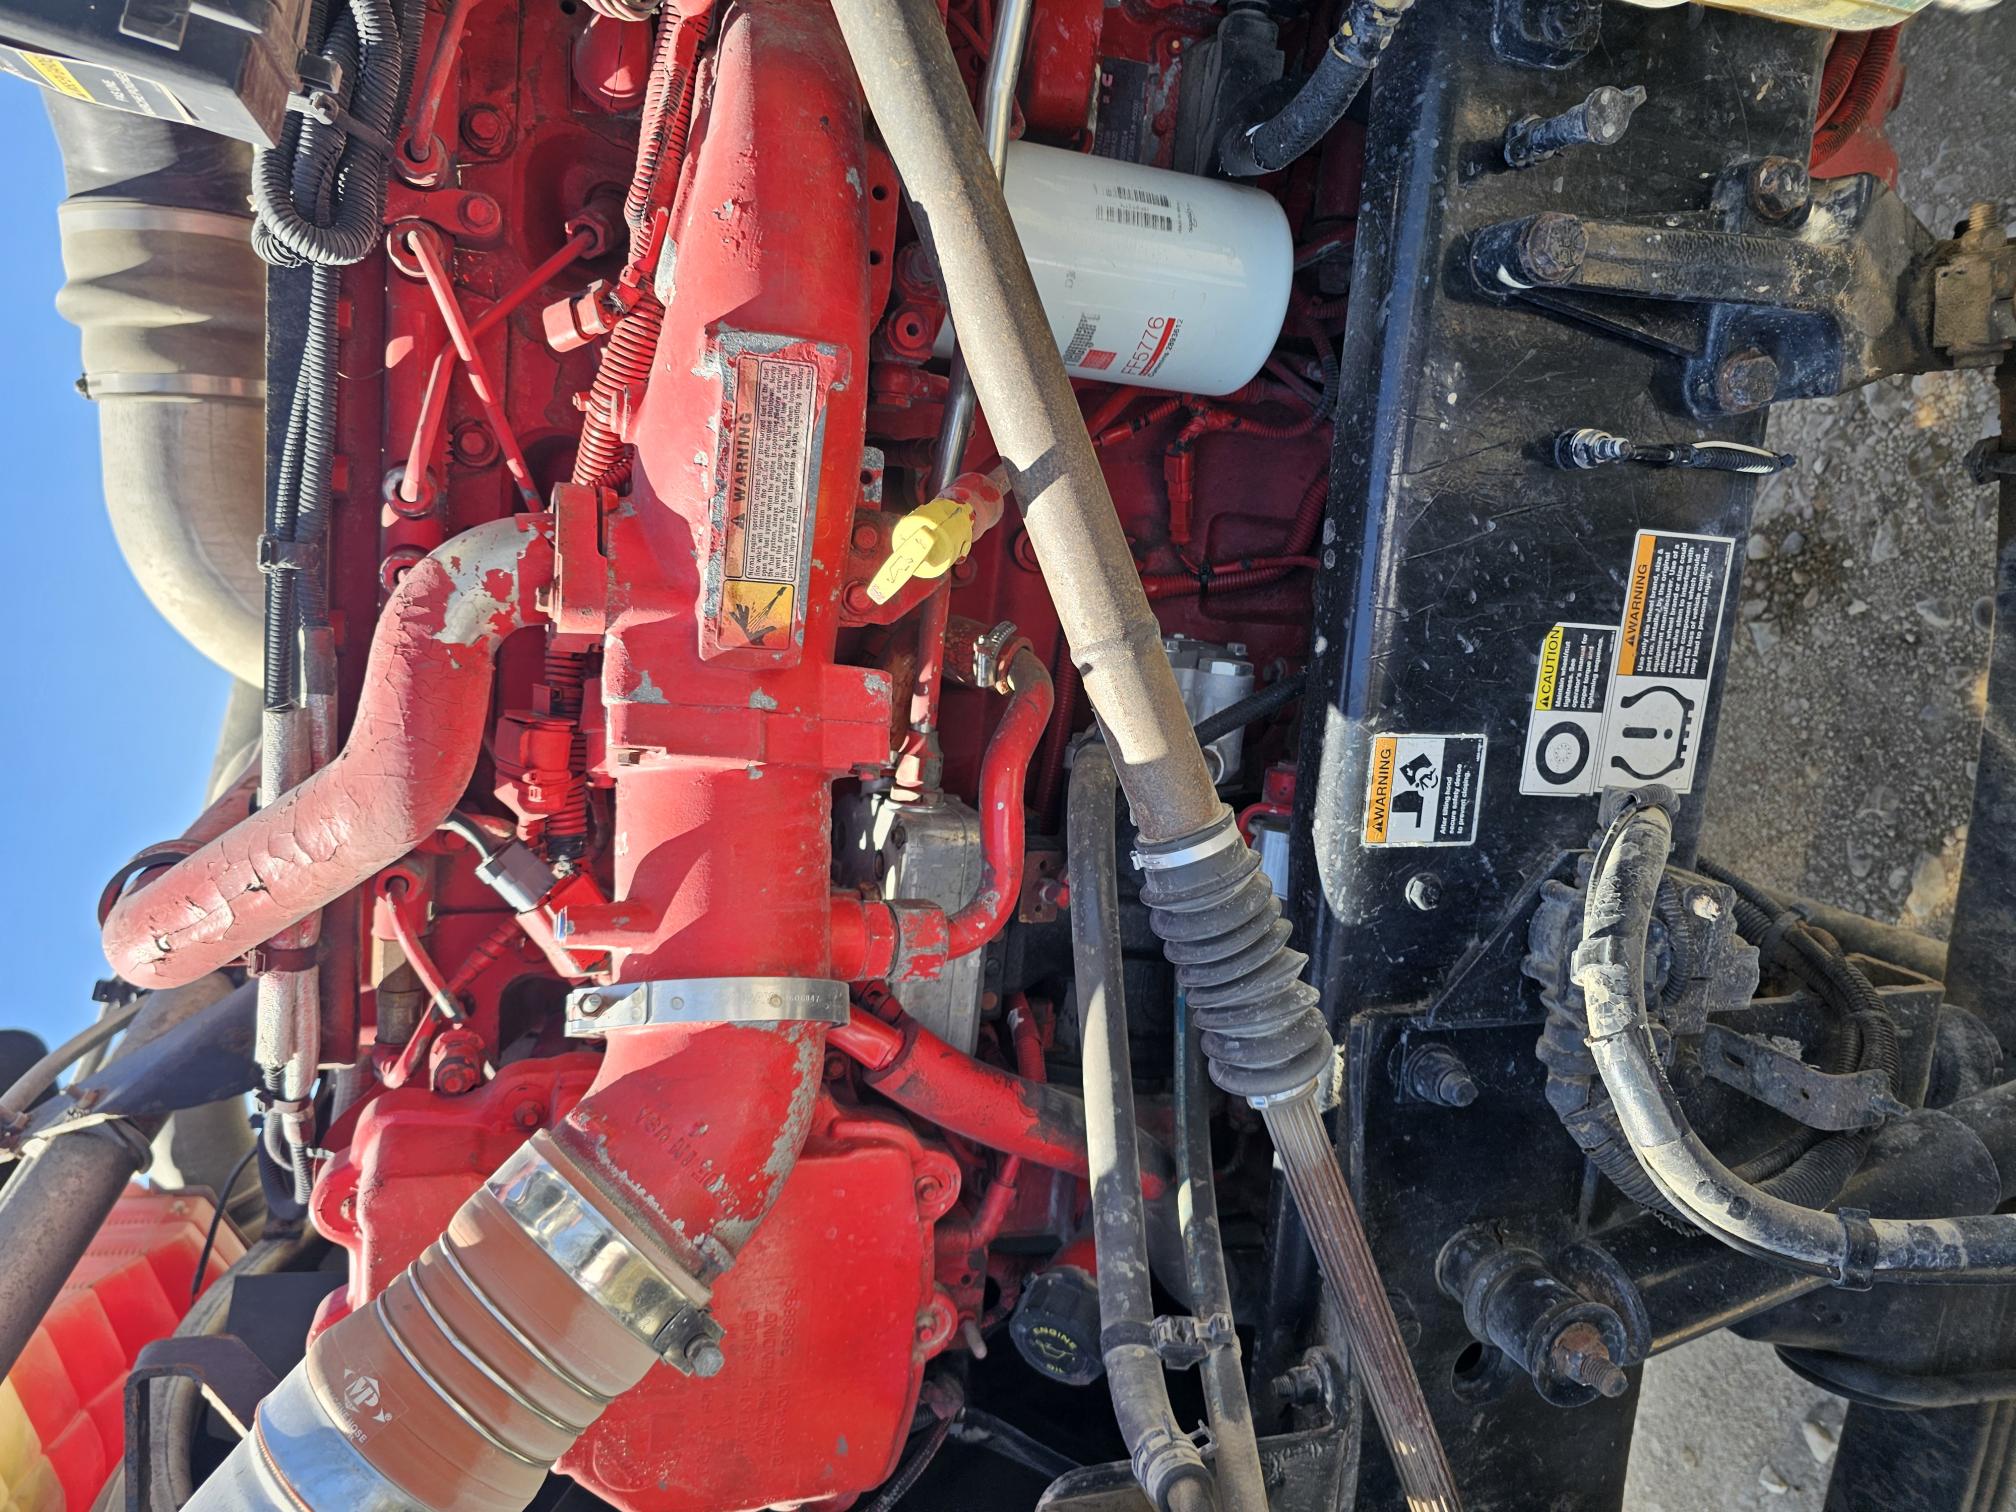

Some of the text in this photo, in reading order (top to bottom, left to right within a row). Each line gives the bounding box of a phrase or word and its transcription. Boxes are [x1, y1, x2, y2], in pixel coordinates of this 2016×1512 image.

[1121, 317, 1164, 375] FF5776
[776, 365, 785, 393] servicing
[793, 402, 802, 428] resulting
[758, 420, 766, 454] pressurized
[734, 414, 752, 502] WARNING
[755, 458, 763, 476] highly
[772, 507, 780, 527] always
[779, 499, 787, 513] Keep
[1650, 574, 1659, 598] brand,
[1656, 598, 1664, 607] by
[1661, 552, 1671, 581] original
[1680, 565, 1691, 597] interfere
[1698, 564, 1706, 591] control
[1627, 565, 1647, 633] WARNING
[1646, 600, 1655, 622] wheel
[1653, 632, 1664, 672] equipment
[1660, 578, 1674, 630] manufacturer.
[1669, 561, 1677, 575] Use
[1673, 551, 1678, 559] of
[1660, 641, 1670, 672] different
[1666, 617, 1674, 639] wheel
[1670, 593, 1679, 615] brand
[1675, 583, 1680, 591] or
[1680, 543, 1688, 564] could
[1676, 646, 1684, 667] brake
[1681, 602, 1692, 644] component
[1688, 577, 1696, 600] which
[1693, 554, 1701, 575] could
[1679, 599, 1685, 607] to
[1692, 593, 1701, 619] vehicle
[1690, 571, 1713, 674] may lead to personal injury.
[1690, 621, 1696, 629] of
[1641, 638, 1649, 655] only
[1672, 629, 1680, 649] valve
[1685, 648, 1691, 656] to
[1542, 630, 1560, 694] CAUTION
[1583, 661, 1591, 684] torque
[1587, 637, 1603, 708] tightening sequence.
[1637, 657, 1645, 671] Use
[1668, 651, 1676, 673] cause
[1682, 658, 1690, 673] lead
[1563, 673, 1573, 707] tightness.
[1572, 673, 1582, 708] operator's
[1578, 646, 1586, 671] manual
[1555, 678, 1565, 707] Maintain
[1374, 749, 1391, 820] WARNING
[1454, 764, 1462, 787] device
[1462, 771, 1470, 798] closing.
[1442, 796, 1451, 816] tilting
[1452, 788, 1460, 809] safety
[1459, 799, 1467, 825] prevent
[1032, 1326, 1078, 1349] ENGINE
